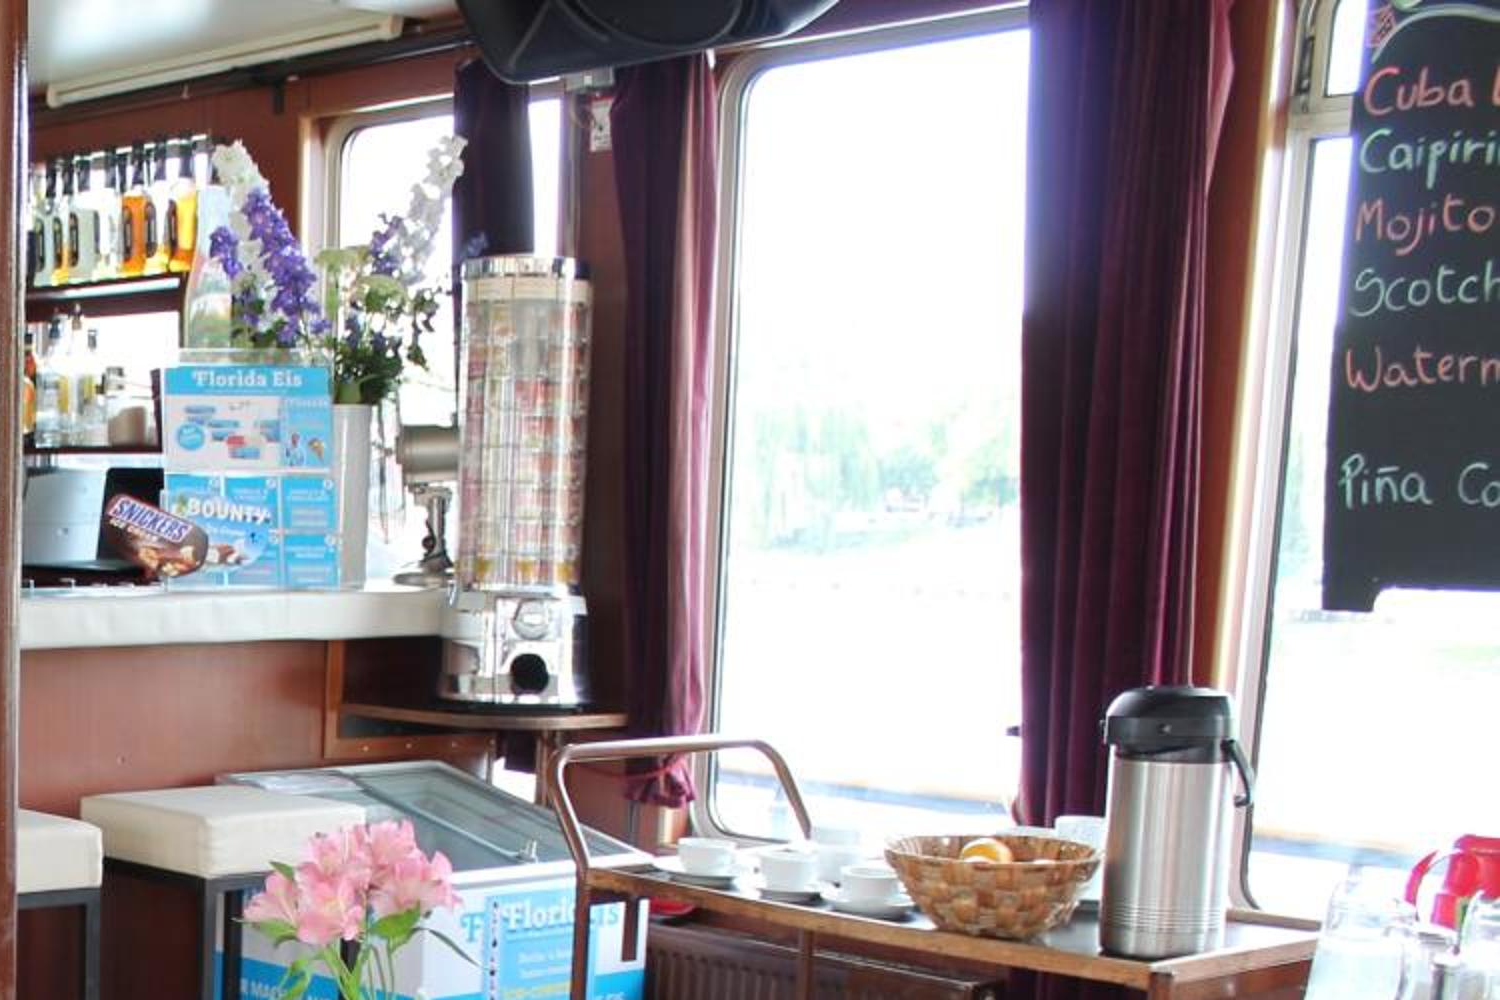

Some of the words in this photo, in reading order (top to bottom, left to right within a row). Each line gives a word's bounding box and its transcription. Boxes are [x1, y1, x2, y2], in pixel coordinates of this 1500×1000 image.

[1363, 66, 1474, 116] Cuba
[1359, 128, 1500, 190] Caipiri
[1355, 193, 1496, 257] Mojito
[1350, 260, 1500, 317] Scotch
[192, 369, 267, 388] Florida
[273, 371, 302, 387] Eis
[1338, 453, 1434, 510] Piña
[112, 498, 188, 541] SNICKERS
[190, 498, 270, 525] BOUNTY
